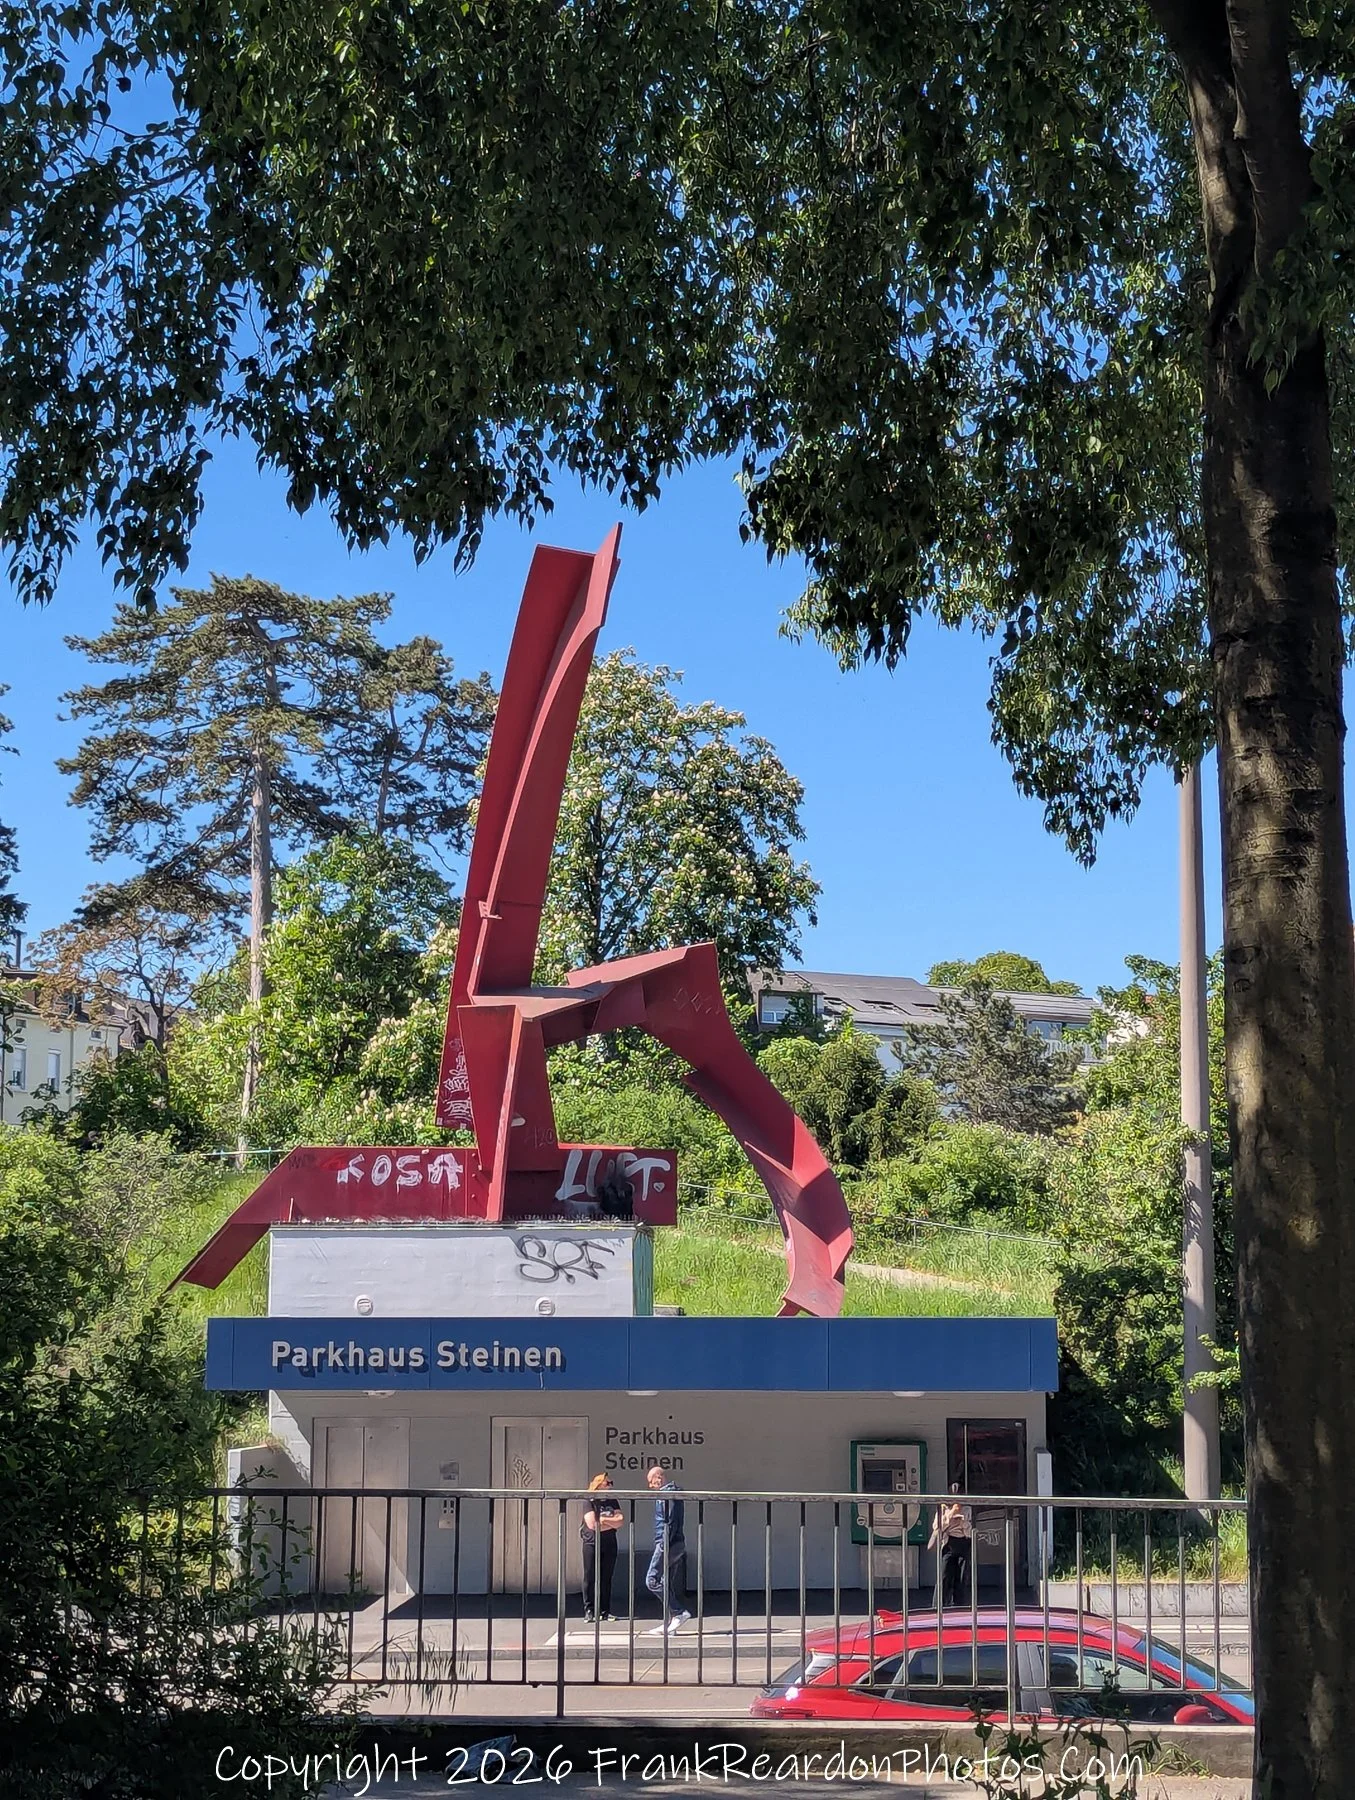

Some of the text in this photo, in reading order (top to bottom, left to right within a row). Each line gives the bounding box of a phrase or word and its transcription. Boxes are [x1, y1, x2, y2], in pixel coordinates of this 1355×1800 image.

[272, 1341, 562, 1367] Parkhaus Steinen
[605, 1427, 704, 1445] Parkhaus
[605, 1452, 684, 1470] Steinen
